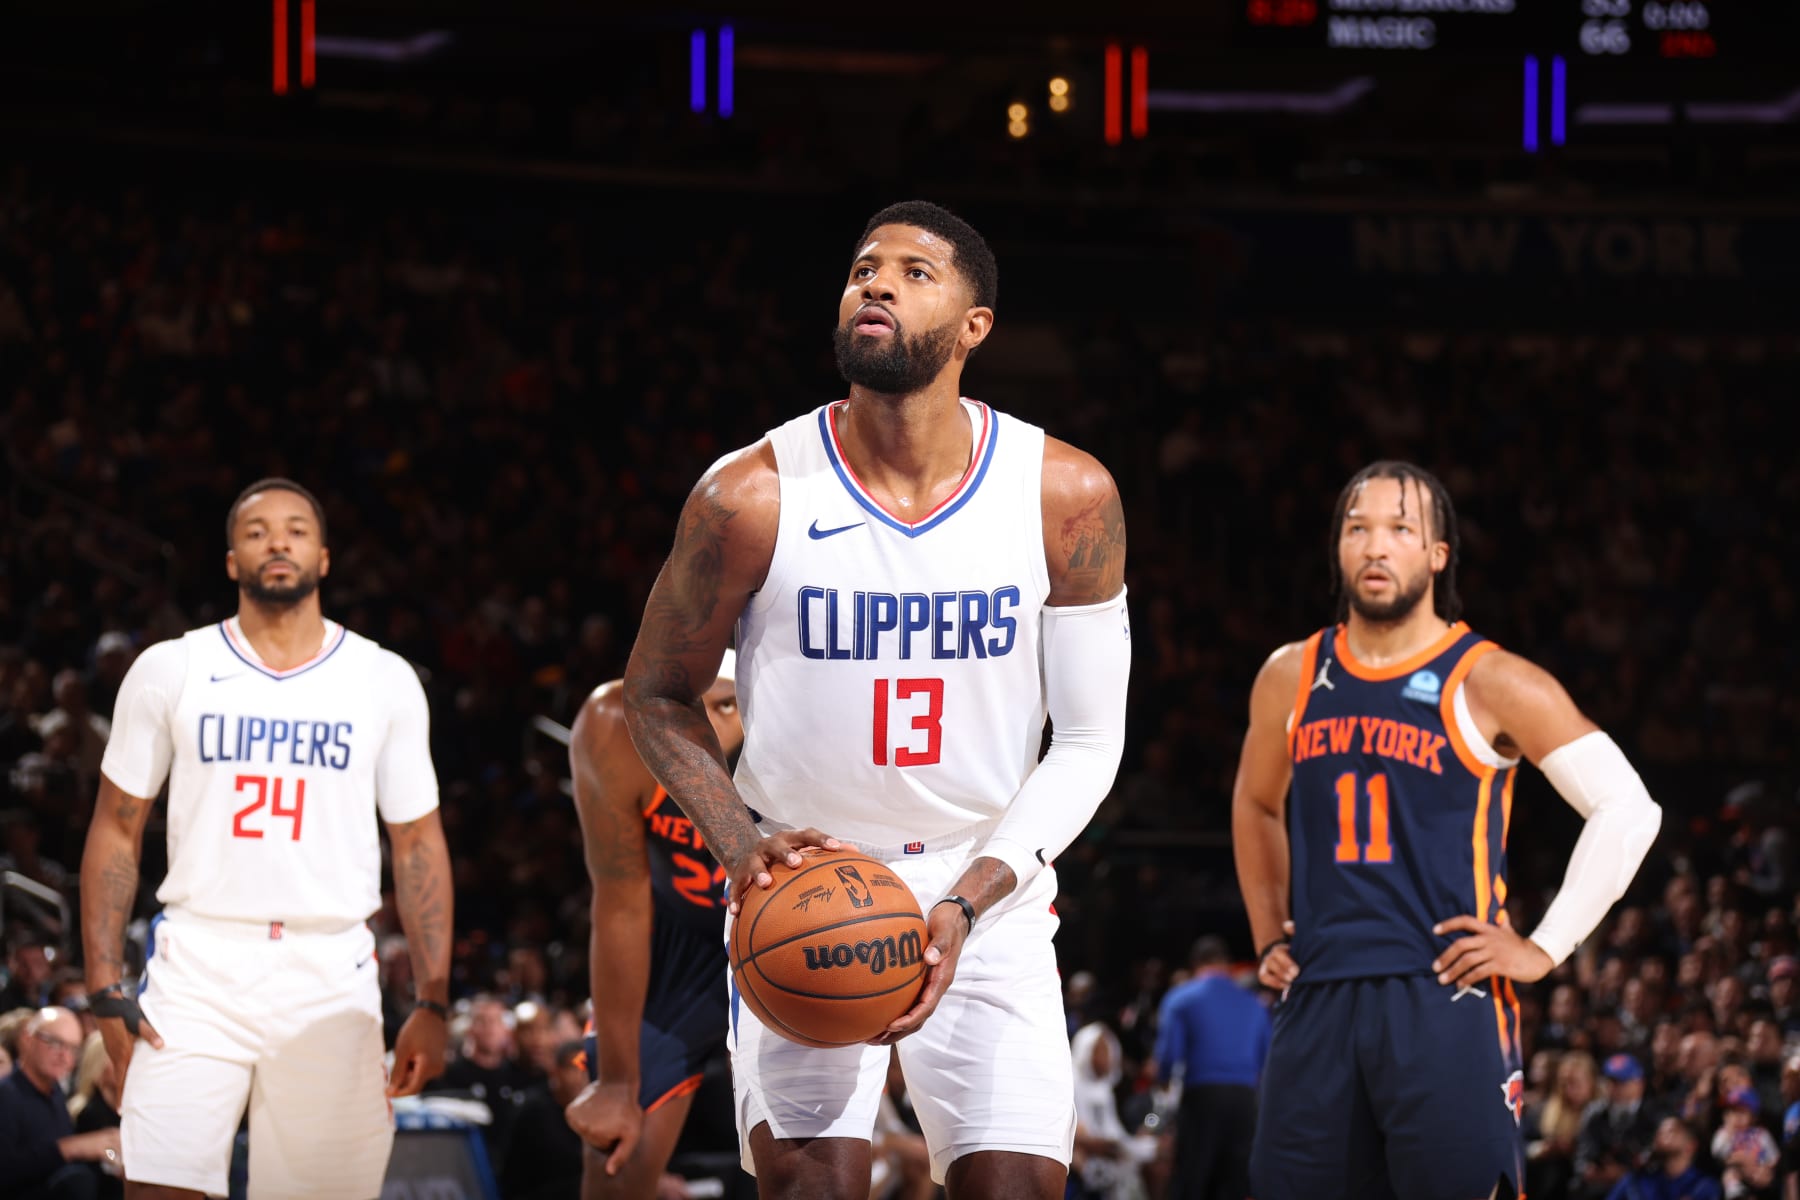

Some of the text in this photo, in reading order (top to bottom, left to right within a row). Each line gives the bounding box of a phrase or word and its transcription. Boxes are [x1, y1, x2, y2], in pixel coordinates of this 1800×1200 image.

[1328, 15, 1436, 49] MAGIC
[1355, 216, 1743, 279] NEW YORK
[798, 585, 1021, 660] CLIPPERS
[199, 714, 352, 770] CLIPPERS
[873, 678, 944, 767] 13
[1295, 716, 1446, 775] NEW YORK
[233, 774, 305, 842] 24
[1334, 771, 1393, 864] 11
[672, 853, 727, 907] 2
[803, 929, 922, 975] Wilson
